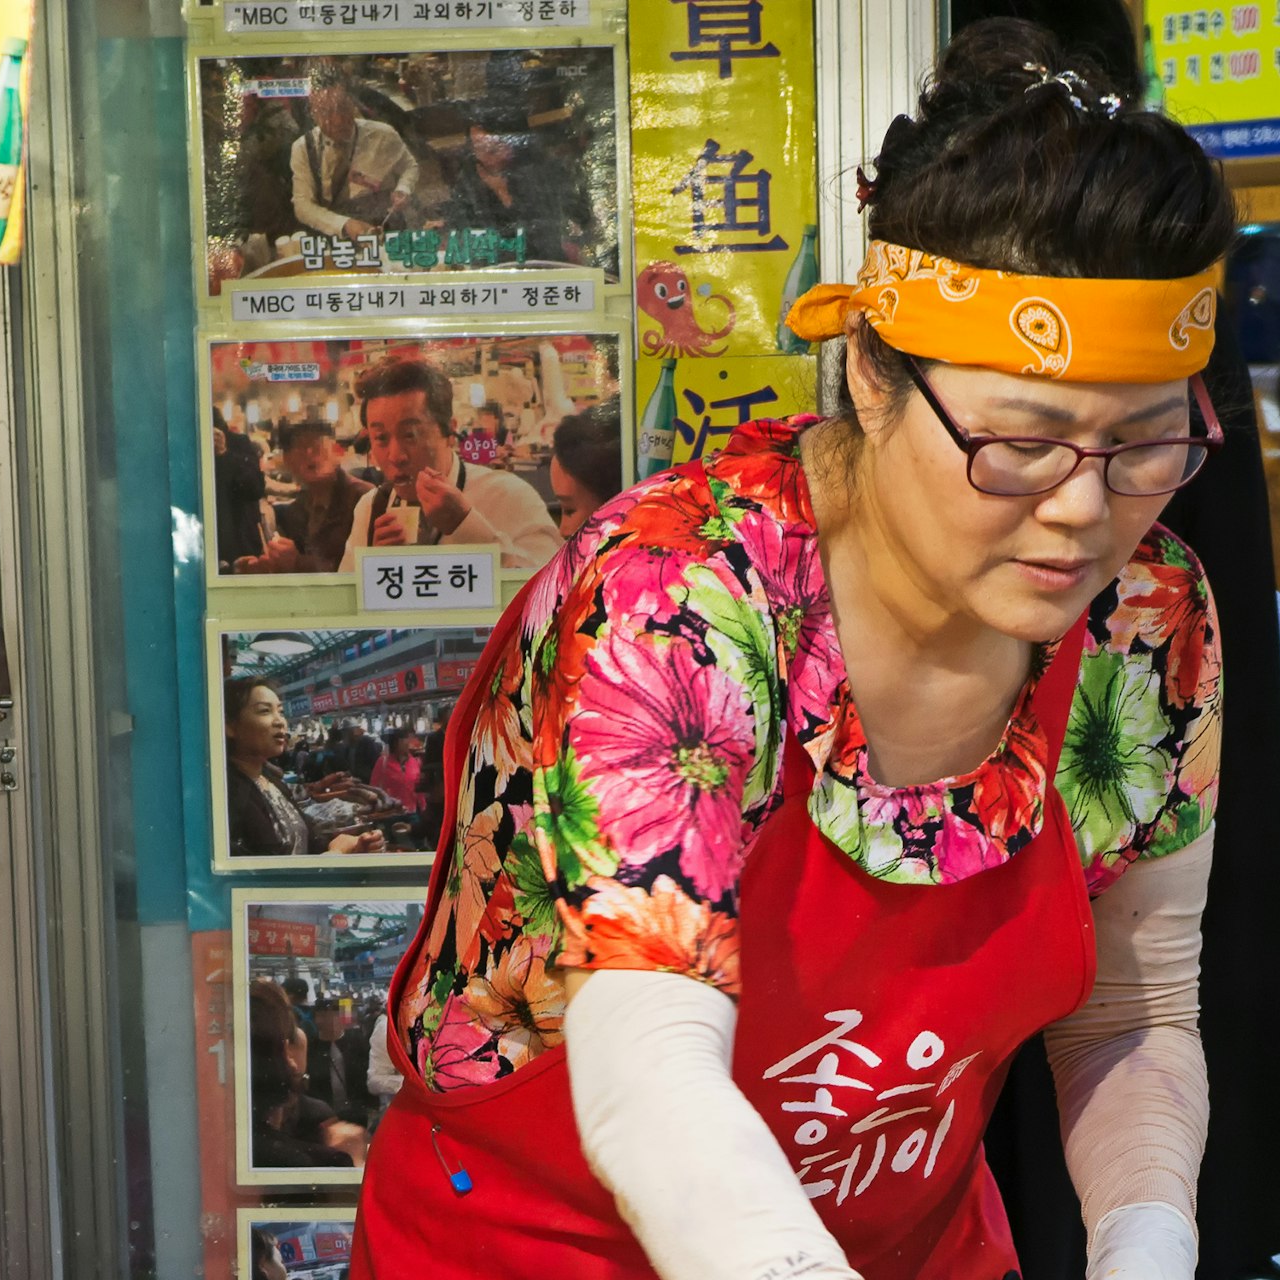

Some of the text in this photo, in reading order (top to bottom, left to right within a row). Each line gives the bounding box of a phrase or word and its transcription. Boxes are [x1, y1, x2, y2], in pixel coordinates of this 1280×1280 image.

[242, 284, 582, 315] "MBC 띠동갑내기 과외하기" 정준하
[376, 564, 478, 599] 정준하
